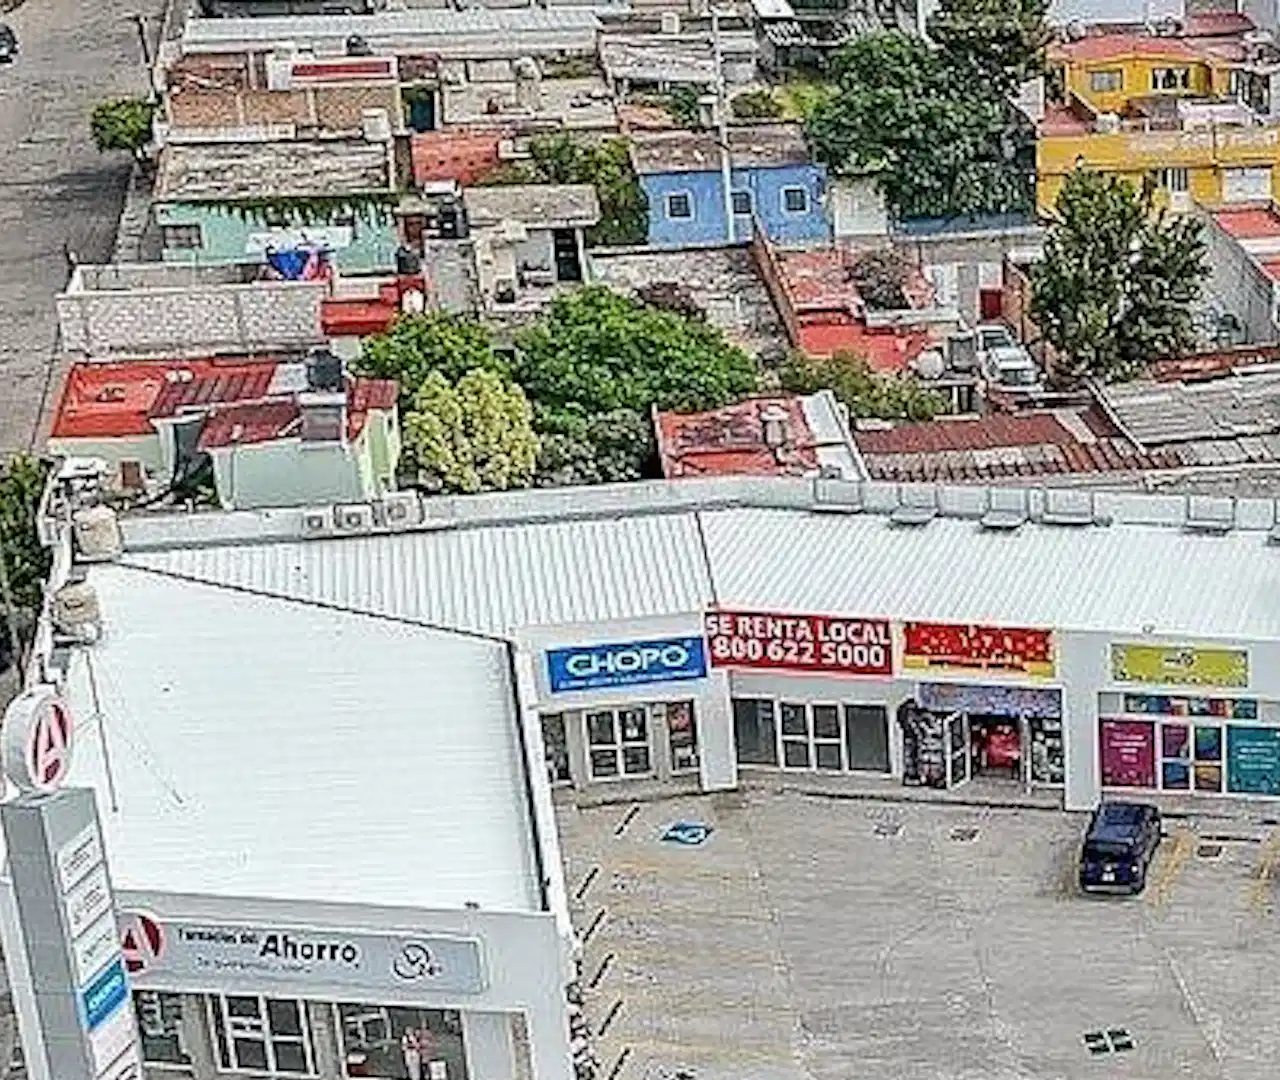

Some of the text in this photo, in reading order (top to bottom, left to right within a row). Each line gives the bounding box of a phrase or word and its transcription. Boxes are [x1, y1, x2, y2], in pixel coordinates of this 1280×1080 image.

[706, 614, 733, 636] SE
[736, 616, 814, 642] RENTA
[818, 620, 891, 646] LOCAL
[566, 644, 690, 677] CHOPO
[712, 636, 763, 661] 800
[767, 639, 816, 665] 622
[820, 643, 885, 668] 5000
[258, 933, 356, 963] Ahorro
